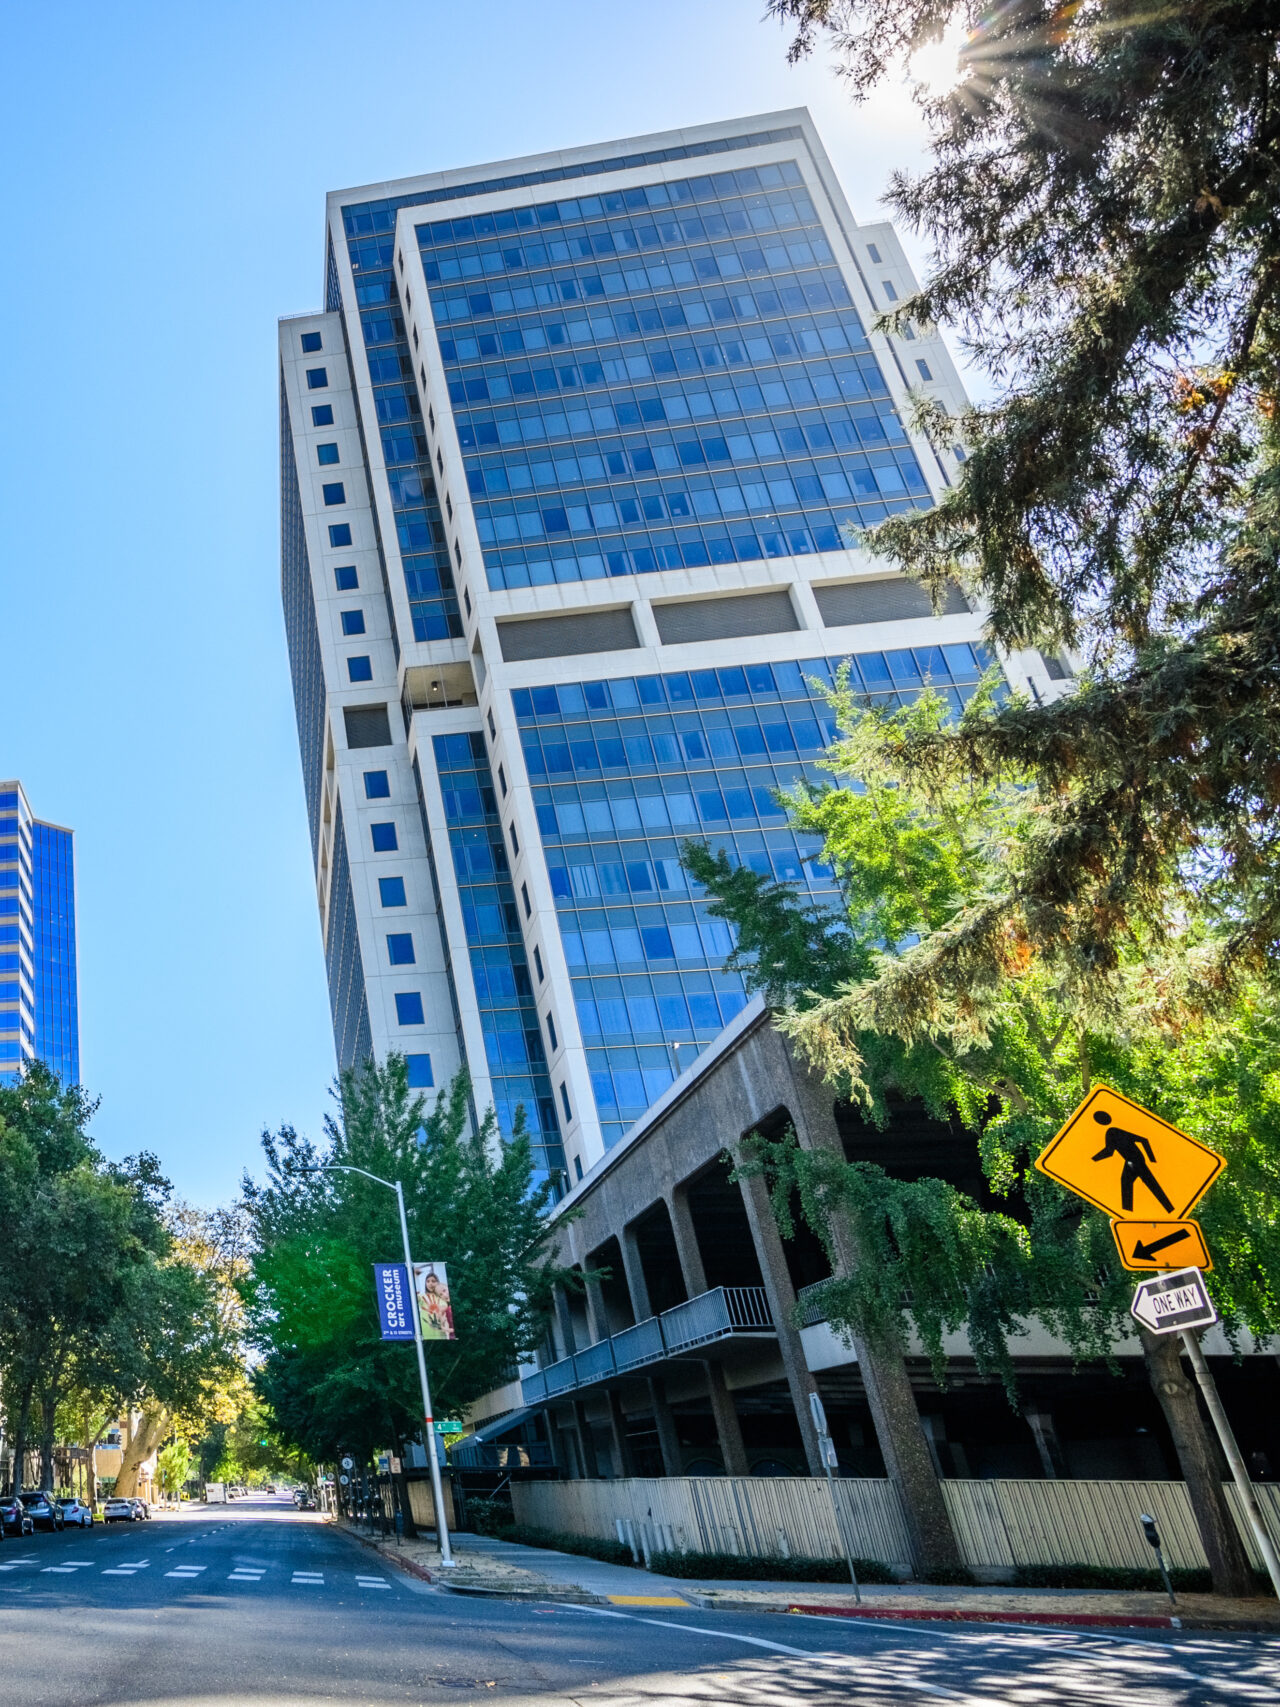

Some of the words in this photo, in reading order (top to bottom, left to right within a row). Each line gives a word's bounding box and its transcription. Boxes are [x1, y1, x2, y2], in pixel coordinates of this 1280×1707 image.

[382, 1269, 398, 1328] CROCKER
[392, 1269, 404, 1310] museum
[1152, 1294, 1176, 1315] ONE
[1173, 1287, 1197, 1309] WAY
[397, 1312, 406, 1328] art
